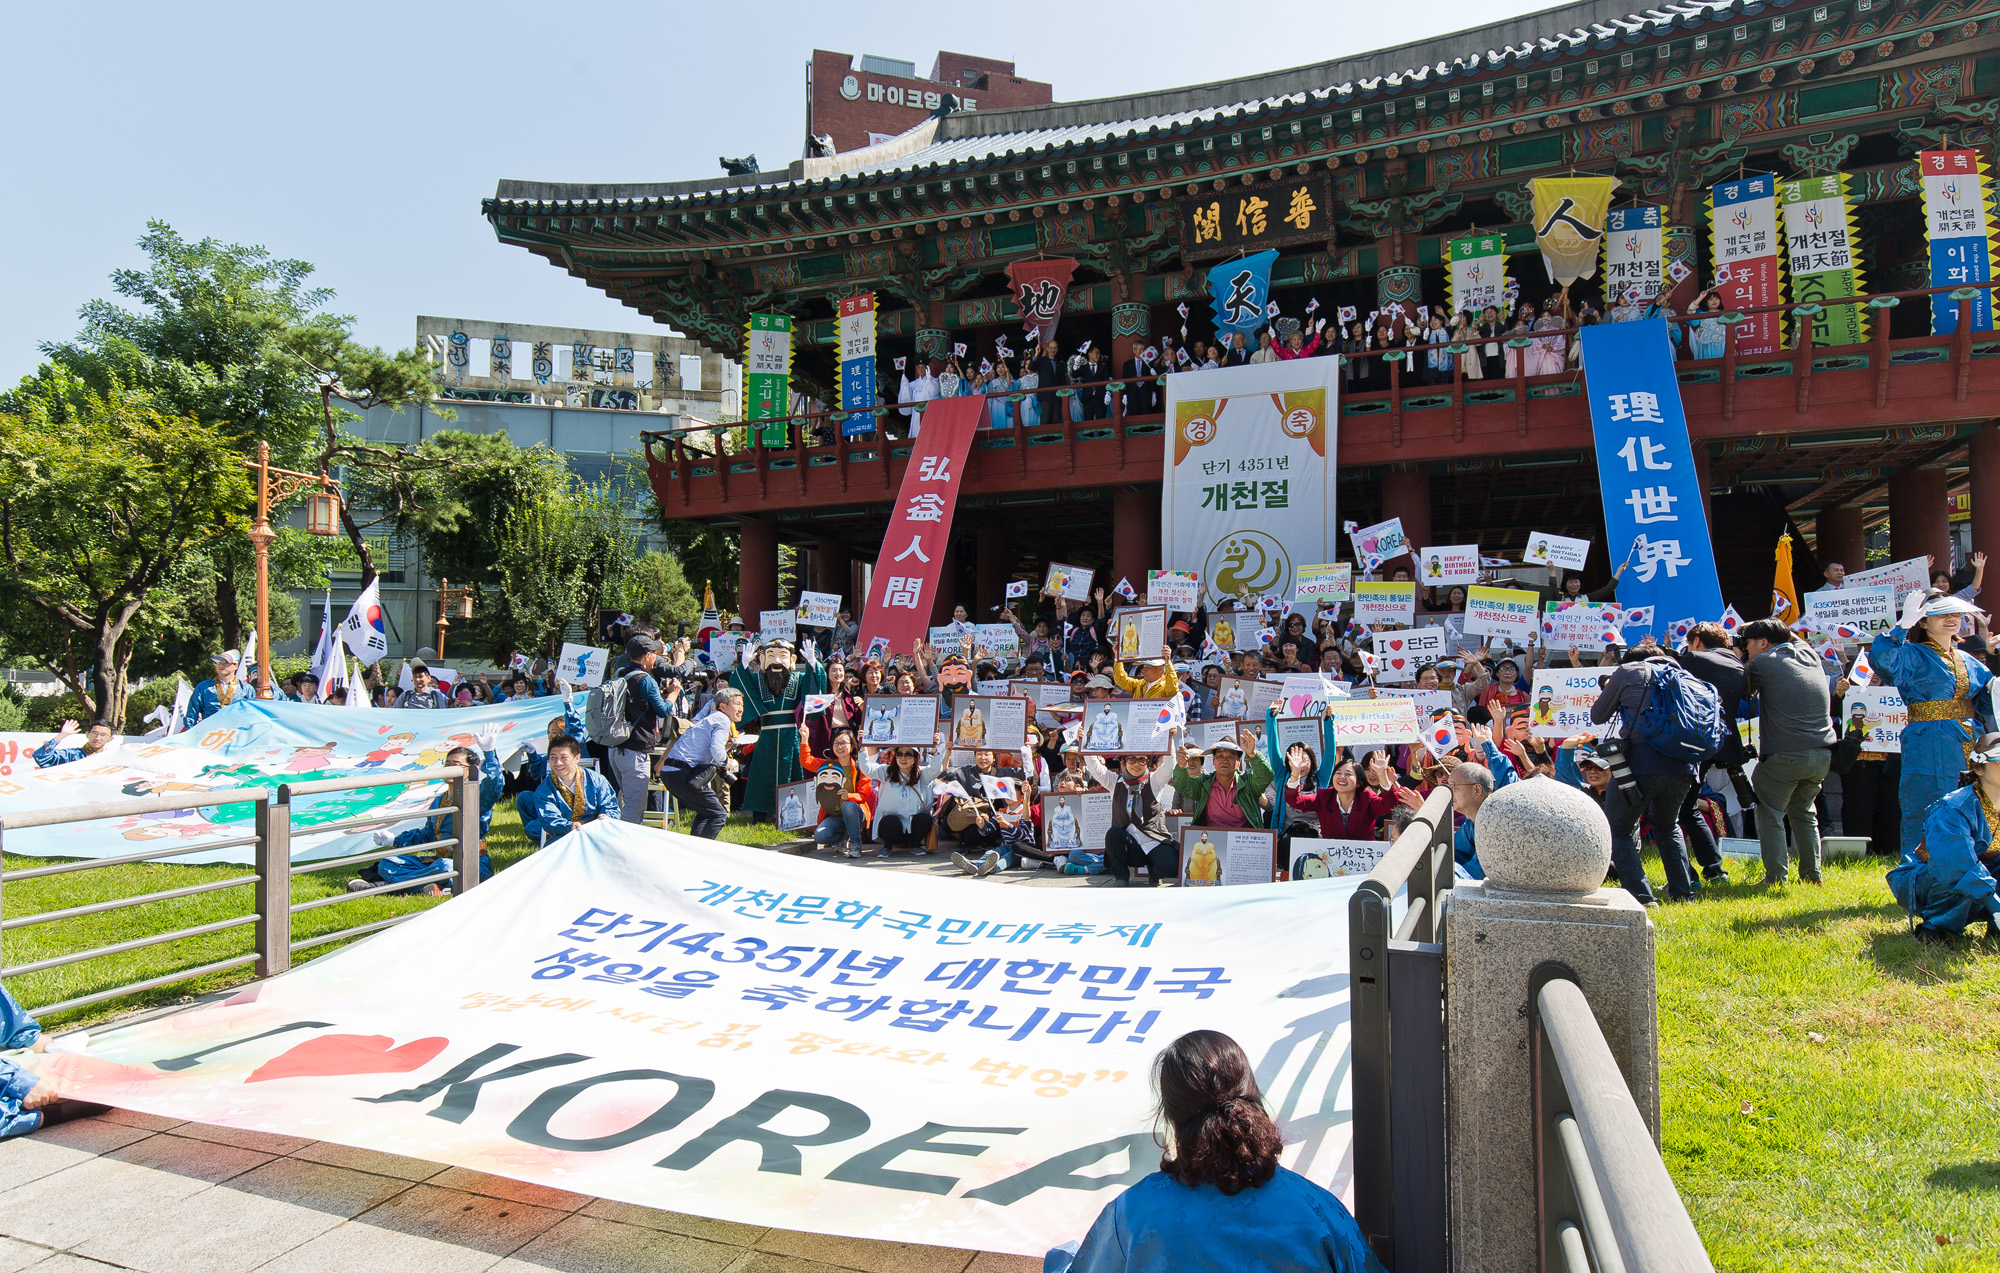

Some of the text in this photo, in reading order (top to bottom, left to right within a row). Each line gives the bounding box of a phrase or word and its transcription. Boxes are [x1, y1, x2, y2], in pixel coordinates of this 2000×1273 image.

[867, 82, 977, 111] 마이크임트
[1538, 197, 1603, 241] 人
[1936, 208, 1976, 221] 개천절
[1724, 230, 1766, 246] 개천절
[1790, 229, 1847, 249] 개천절
[1609, 260, 1661, 277] 개천절
[1791, 249, 1849, 273] 開天節
[1760, 262, 1768, 282] Widely
[1019, 280, 1061, 320] 地
[1761, 283, 1769, 303] Benefit
[1202, 455, 1290, 476] 단기 4351년
[1201, 479, 1289, 512] 개천절
[1608, 391, 1692, 583] 理化世界
[882, 456, 951, 609] 弘益人間
[1357, 593, 1412, 602] 한민족의 통일은
[1362, 603, 1407, 611] 개천정신으로
[1470, 599, 1534, 614] 한민족의 통일은
[1813, 598, 1850, 609] 4350번째
[1851, 595, 1887, 606] 대한민국
[1474, 611, 1527, 623] 개천정신으로
[1815, 608, 1839, 618] 생일을
[1841, 605, 1887, 616] 축하합니다!
[1379, 636, 1438, 653] I 단군
[1381, 658, 1388, 672] I
[1335, 712, 1395, 721] Happy Birthday
[684, 879, 1164, 948] 개천문화국민대축제
[557, 907, 1232, 1000] 단기4351년 대한민국
[531, 947, 1162, 1044] 생일을 축하합니다!
[784, 1031, 950, 1068] 평화와
